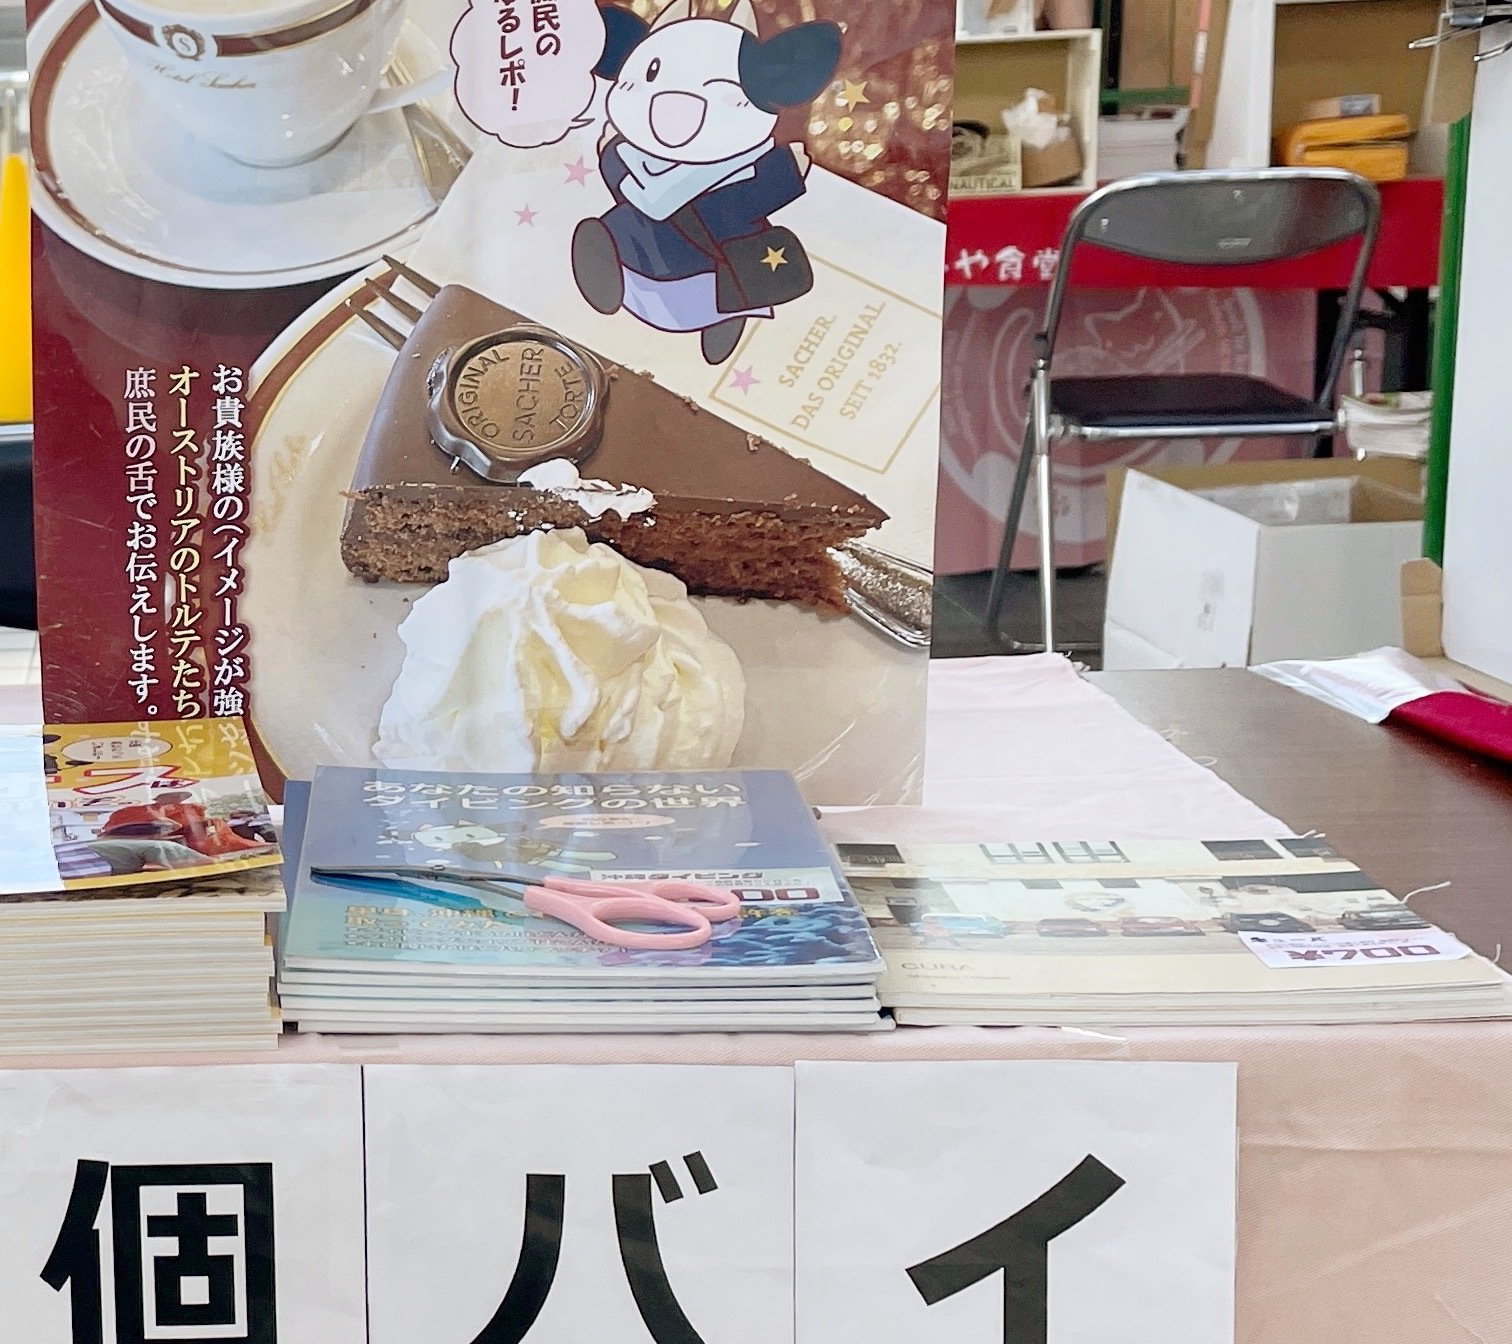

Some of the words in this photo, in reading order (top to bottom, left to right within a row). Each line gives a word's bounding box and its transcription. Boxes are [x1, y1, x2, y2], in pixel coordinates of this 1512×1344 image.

[945, 245, 1060, 282] や食堂
[778, 313, 838, 388] SACHER.
[791, 393, 825, 432] DAS
[816, 301, 887, 393] ORIGINAL.
[839, 380, 874, 421] SEIT
[867, 341, 904, 381] 1832.
[458, 347, 510, 441] ORIGINAL
[512, 346, 545, 444] SACHER
[549, 360, 577, 433] TORTE
[123, 366, 159, 717] 庶民の舌でお伝えします。
[169, 365, 202, 719] オーストリアのトルテたち
[363, 780, 742, 796] あなたの知らない
[363, 795, 746, 810] ダイビングの世界
[1286, 944, 1440, 961] ¥700
